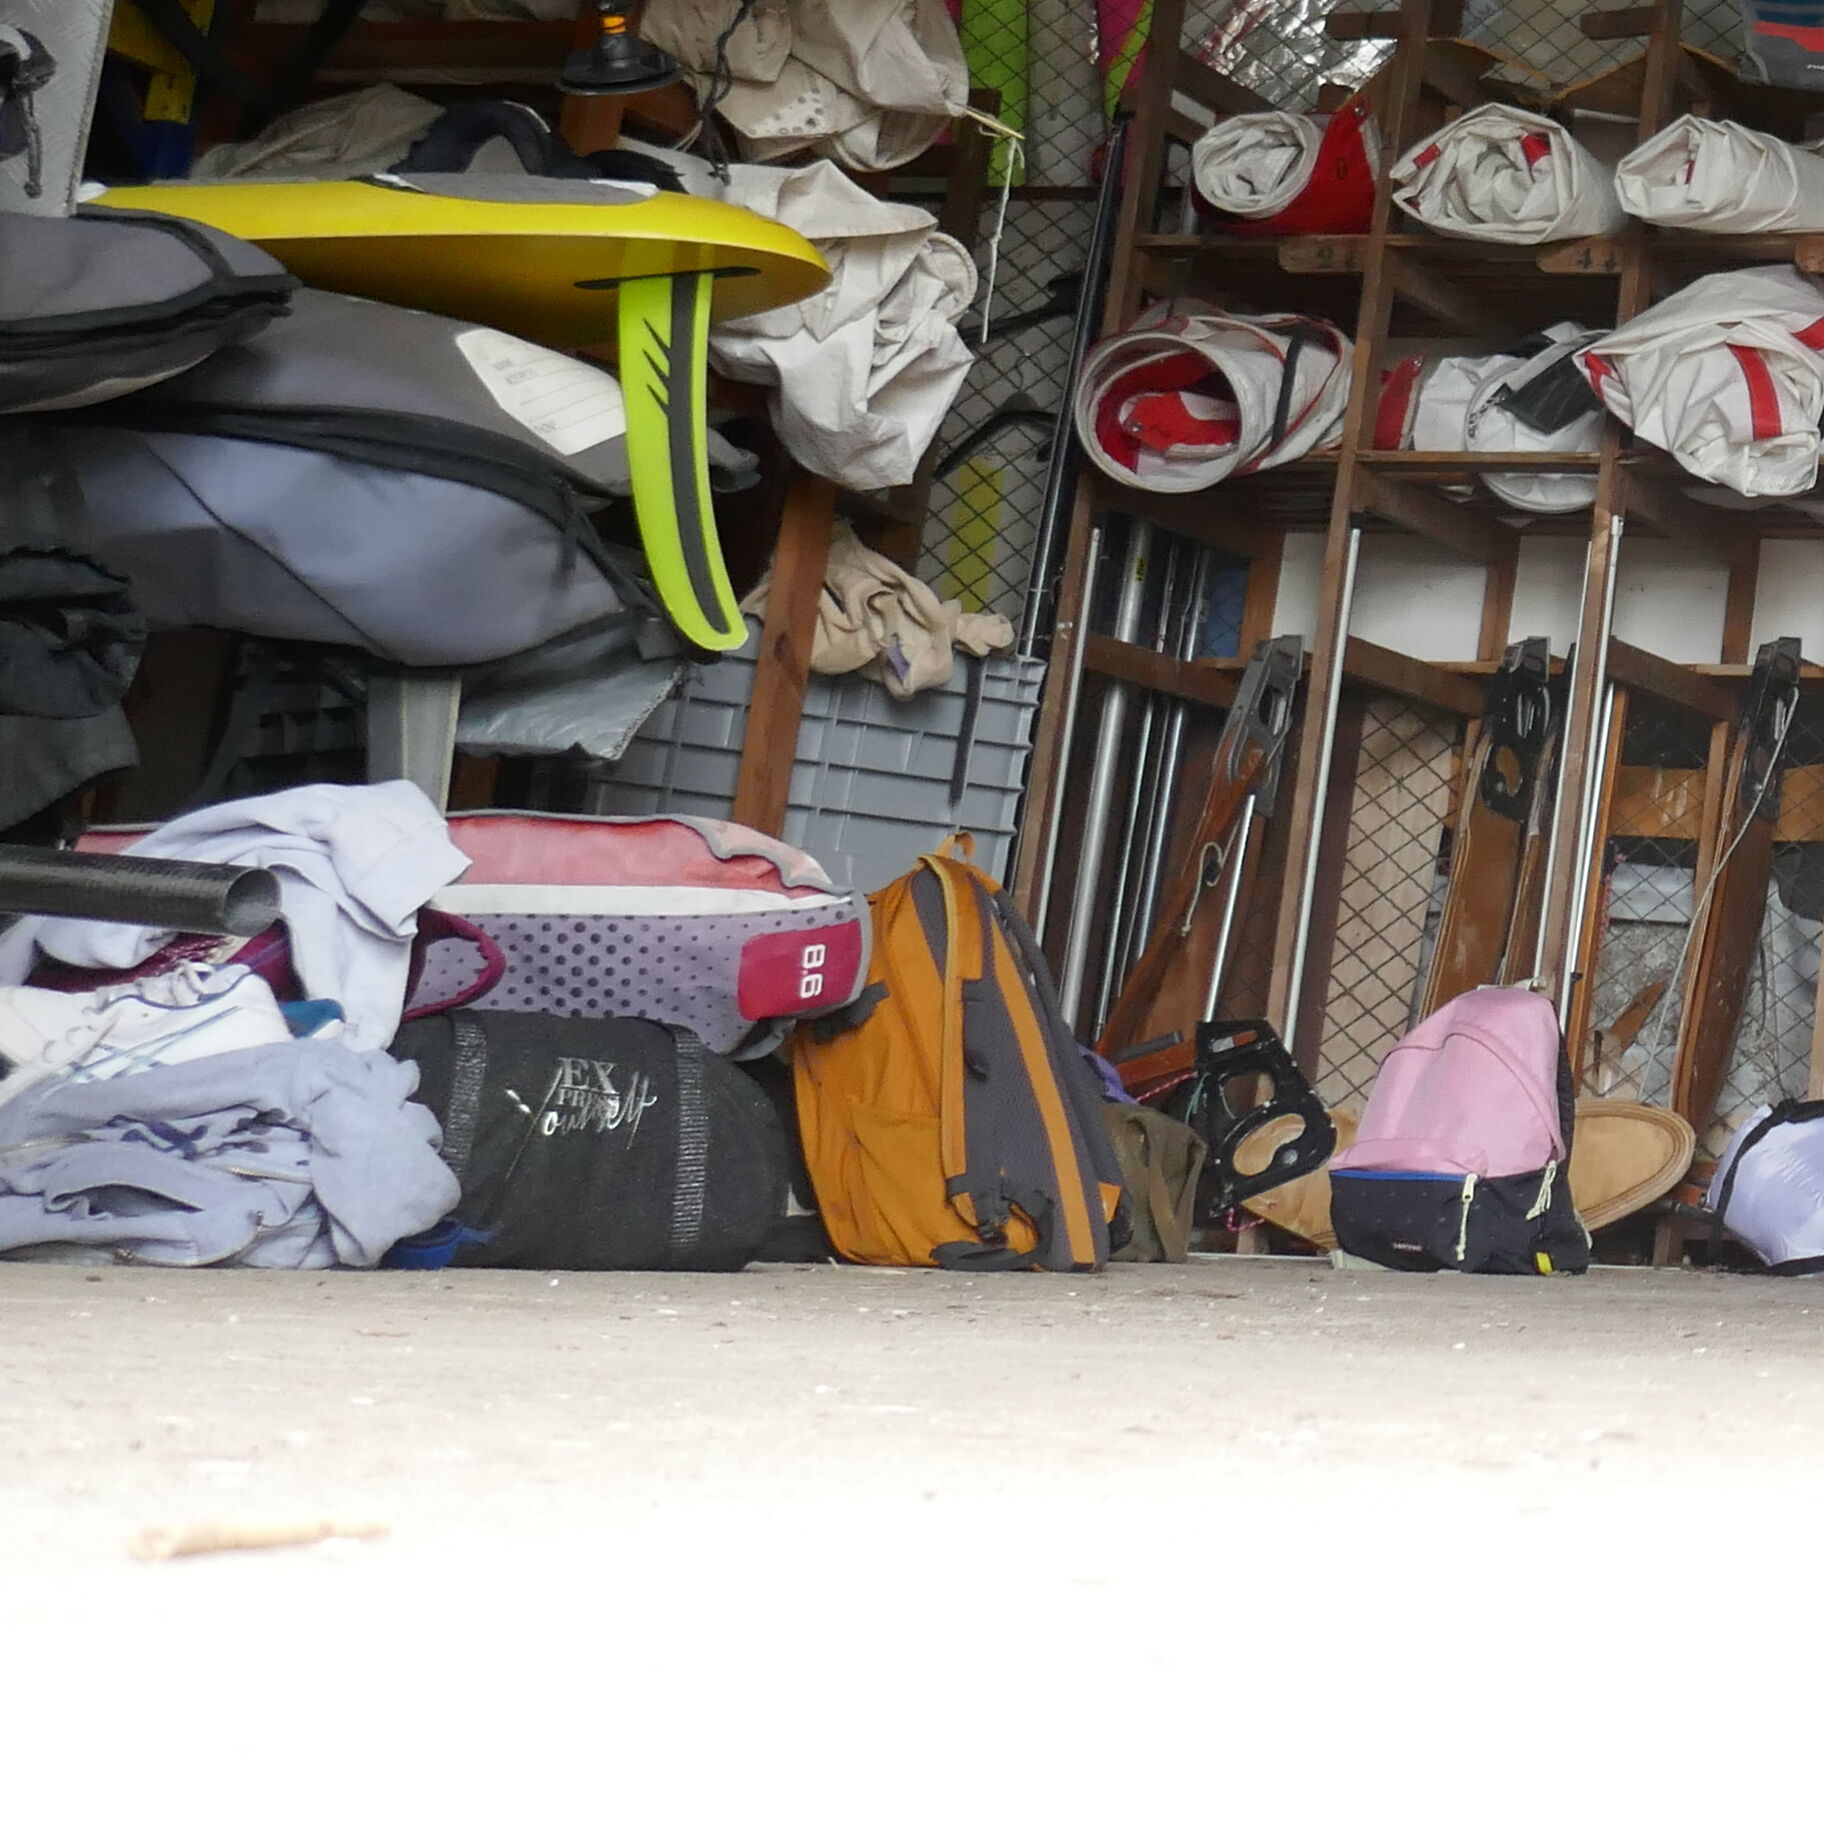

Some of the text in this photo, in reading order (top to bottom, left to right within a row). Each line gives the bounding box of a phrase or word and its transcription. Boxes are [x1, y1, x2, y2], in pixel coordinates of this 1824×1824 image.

[1577, 246, 1594, 270] 4
[799, 943, 827, 1000] 8.6
[557, 1056, 619, 1094] EX
